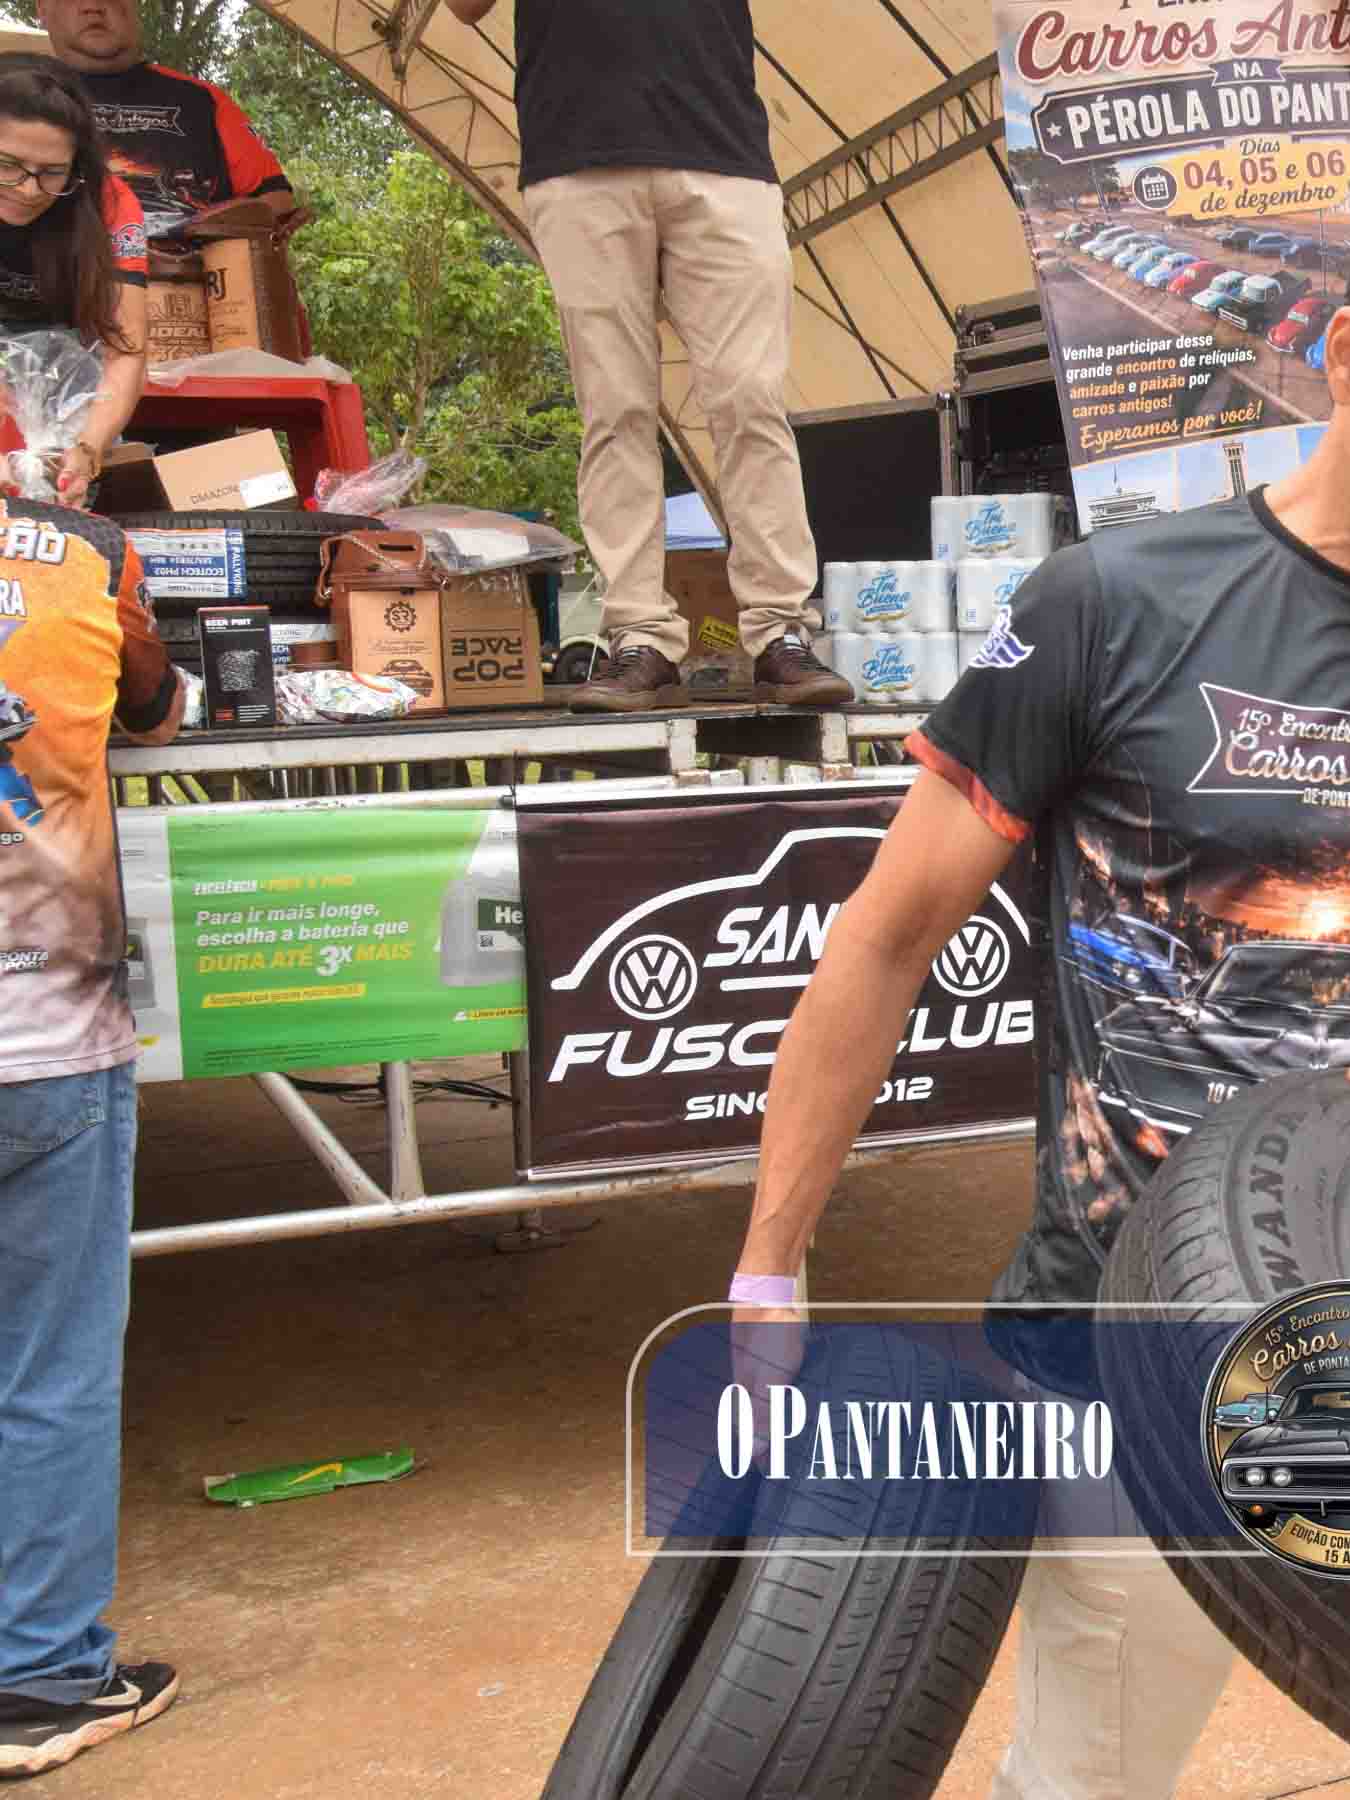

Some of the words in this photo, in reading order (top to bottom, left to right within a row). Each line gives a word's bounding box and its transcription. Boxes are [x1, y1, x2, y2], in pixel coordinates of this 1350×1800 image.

[1017, 10, 1218, 80] Carros
[1232, 61, 1264, 79] NA
[1066, 89, 1211, 149] PÉROLA
[1218, 86, 1260, 128] DO
[1240, 138, 1280, 157] Dias
[1183, 159, 1234, 190] 04,
[1240, 156, 1278, 185] 05
[1285, 161, 1298, 180] e
[1306, 149, 1345, 177] 06
[1200, 190, 1226, 213] de
[1233, 181, 1337, 214] dezembro
[1062, 345, 1104, 361] Venha
[1107, 340, 1172, 360] participar
[1175, 335, 1213, 350] desse
[1065, 363, 1113, 384] grande
[1116, 356, 1176, 375] encontro
[1179, 353, 1196, 368] de
[1199, 348, 1257, 368] relíquias,
[1069, 381, 1125, 401] amizade
[1128, 381, 1137, 393] e
[1139, 373, 1185, 395] paixão
[1188, 371, 1211, 389] por
[1072, 402, 1115, 419] carros
[1118, 394, 1173, 414] antigos!
[1079, 417, 1180, 453] Esperamos
[1183, 413, 1216, 438] por
[1219, 399, 1264, 426] você!
[451, 637, 523, 657] RACE
[452, 658, 526, 683] POP
[1303, 787, 1320, 805] DE
[195, 910, 243, 927] Para
[247, 905, 262, 922] ir
[267, 904, 315, 921] mais
[319, 901, 381, 920] longe,
[196, 926, 277, 948] escolha
[282, 929, 294, 942] a
[298, 921, 369, 942] bateria
[373, 920, 409, 940] que
[197, 951, 266, 974] DURA
[547, 1018, 791, 1083] FUSC
[896, 1000, 1034, 1054] LUB
[684, 1091, 770, 1121] SIN
